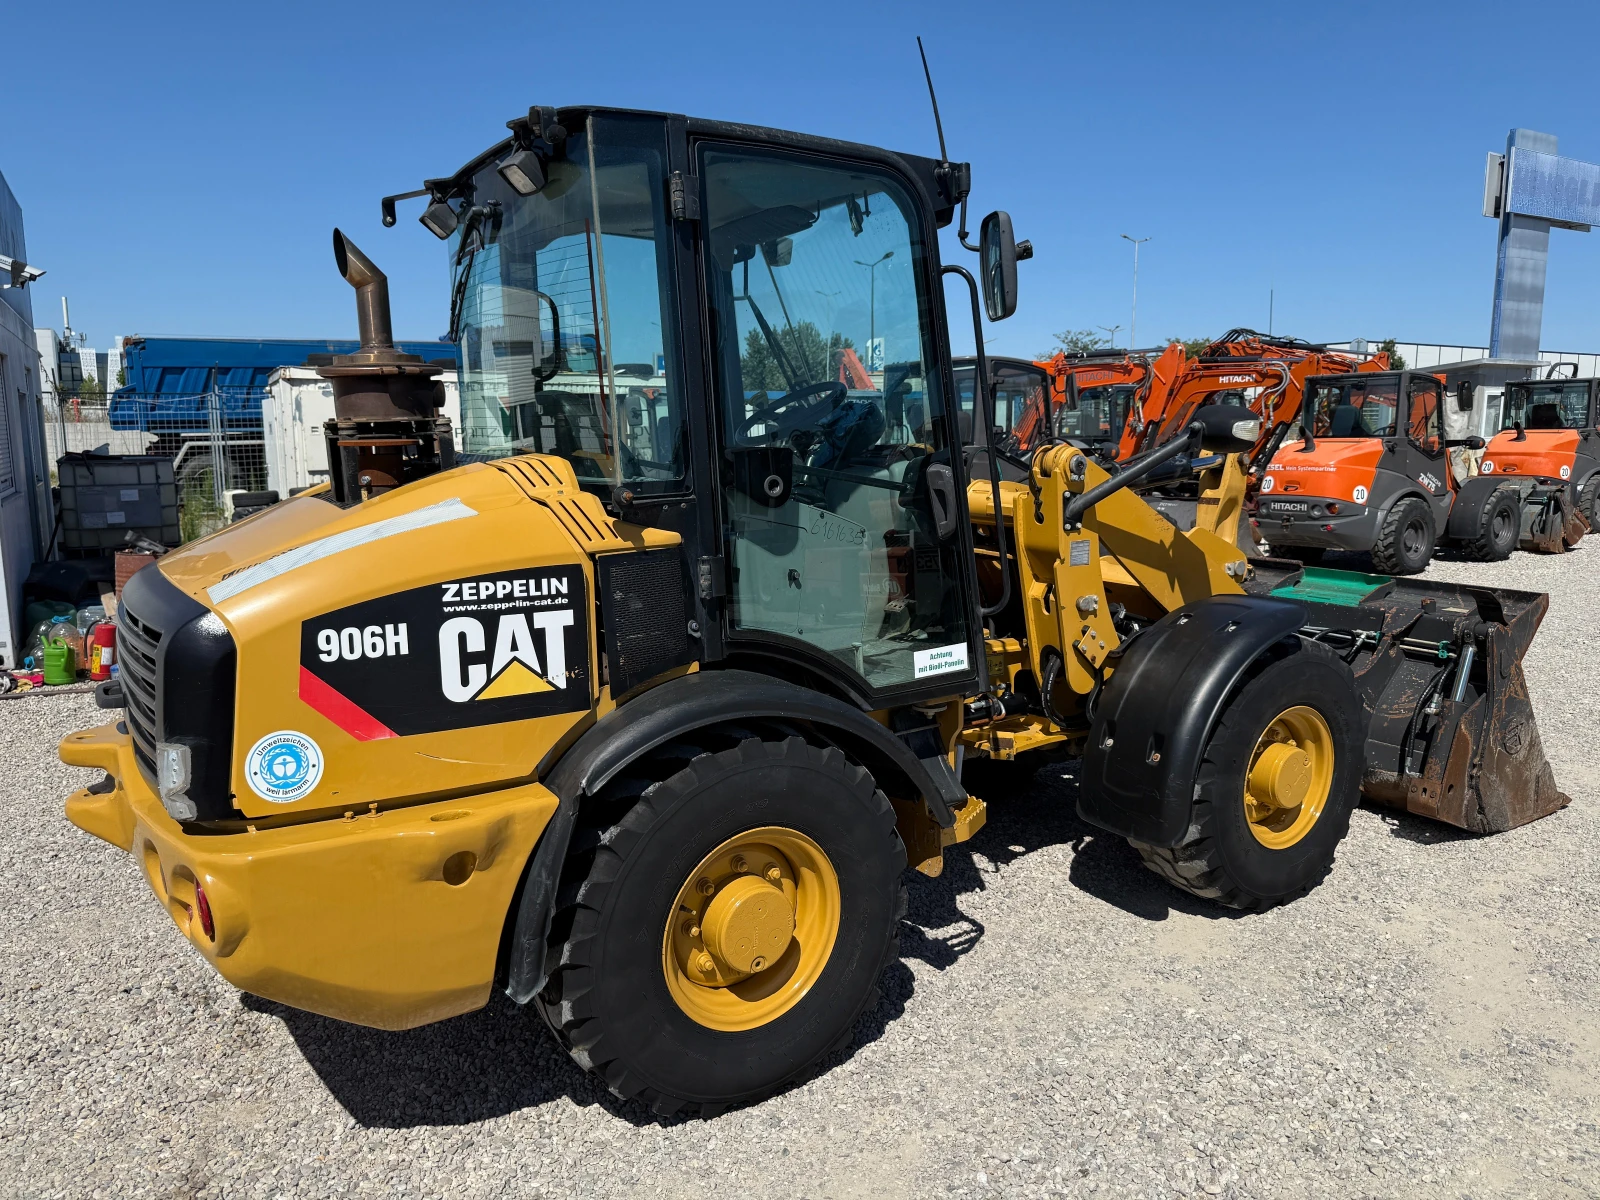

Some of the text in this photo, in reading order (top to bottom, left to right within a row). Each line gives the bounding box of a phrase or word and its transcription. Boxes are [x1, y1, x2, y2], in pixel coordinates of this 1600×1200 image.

[1076, 370, 1114, 382] HITACHI
[1219, 373, 1256, 384] HITACHI
[1298, 464, 1338, 472] Systempartner
[1483, 462, 1492, 472] 20
[1561, 467, 1570, 477] 20
[1262, 479, 1272, 490] 20
[1418, 472, 1436, 492] ZW75
[1355, 488, 1365, 500] 20
[1271, 502, 1308, 512] HITACHI
[811, 518, 864, 545] 6161635
[441, 577, 568, 602] ZEPPELIN
[443, 597, 569, 612] www.zeppelin-cat.de
[317, 622, 410, 663] 906H
[438, 609, 575, 703] CAT
[930, 651, 953, 661] Achtung
[918, 666, 928, 674] mit
[256, 737, 309, 757] Umweltzeichen
[266, 786, 281, 796] weil
